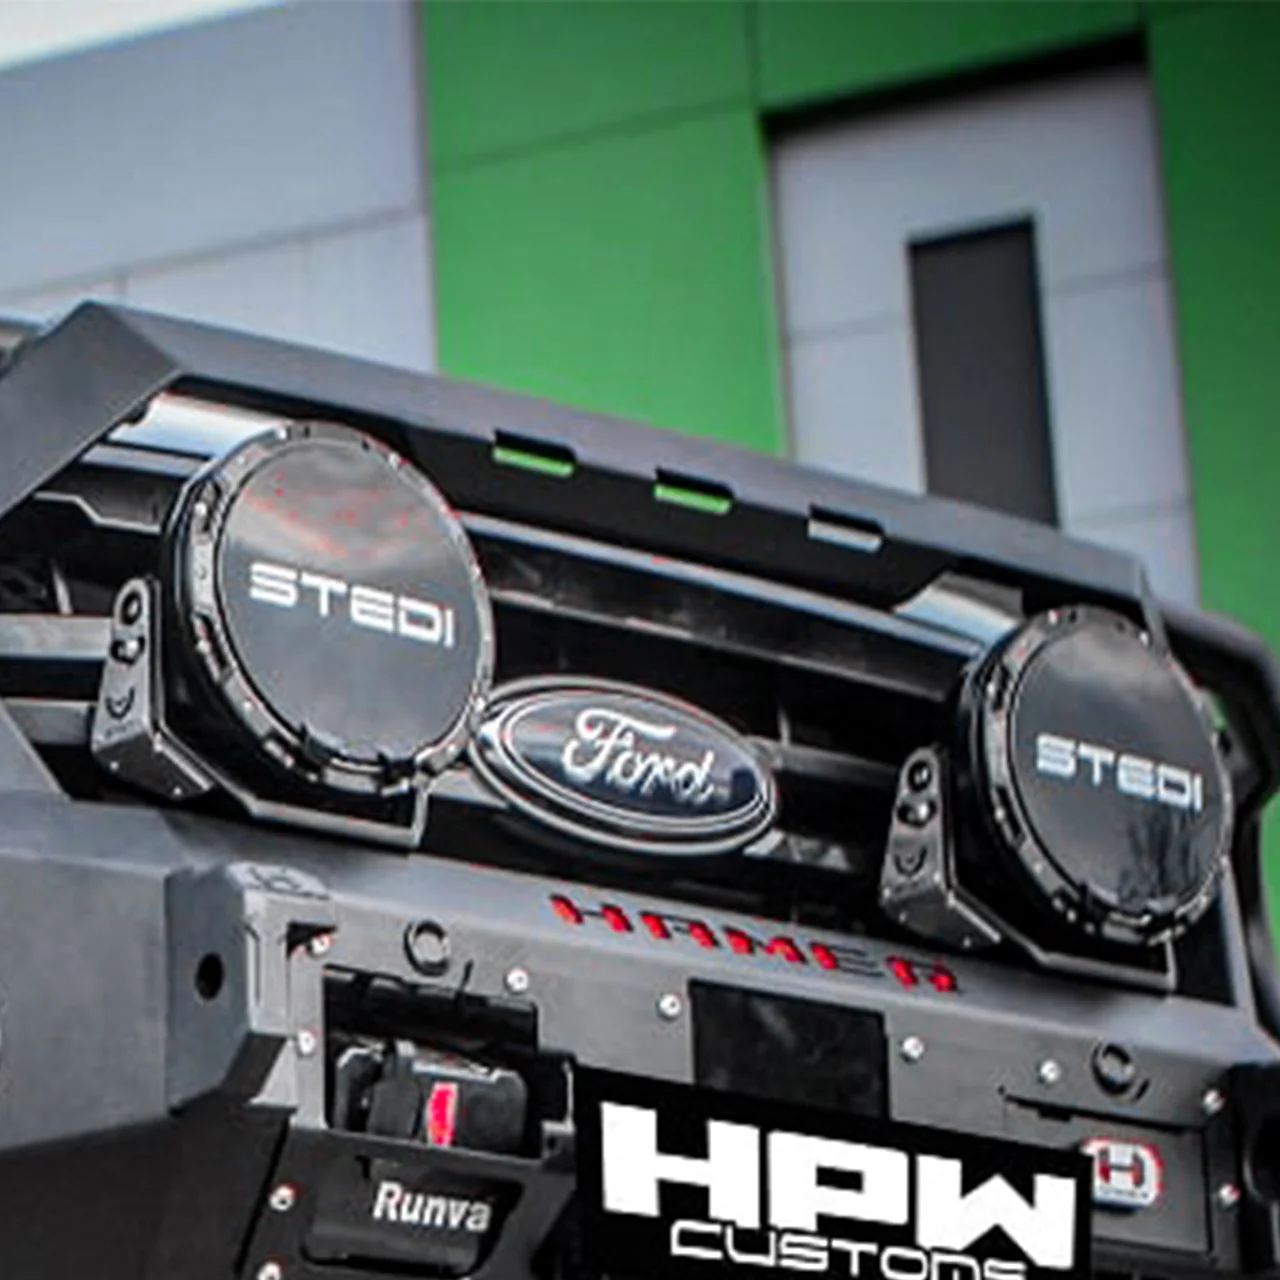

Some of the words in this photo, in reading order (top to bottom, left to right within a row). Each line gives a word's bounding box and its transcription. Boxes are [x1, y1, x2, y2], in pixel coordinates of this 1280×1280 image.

[249, 560, 454, 649] STEDI
[561, 707, 717, 803] Ford
[1035, 733, 1204, 813] STEDI
[549, 893, 961, 995] HAMER
[372, 1180, 492, 1233] Runva
[600, 1100, 1077, 1271] HPW
